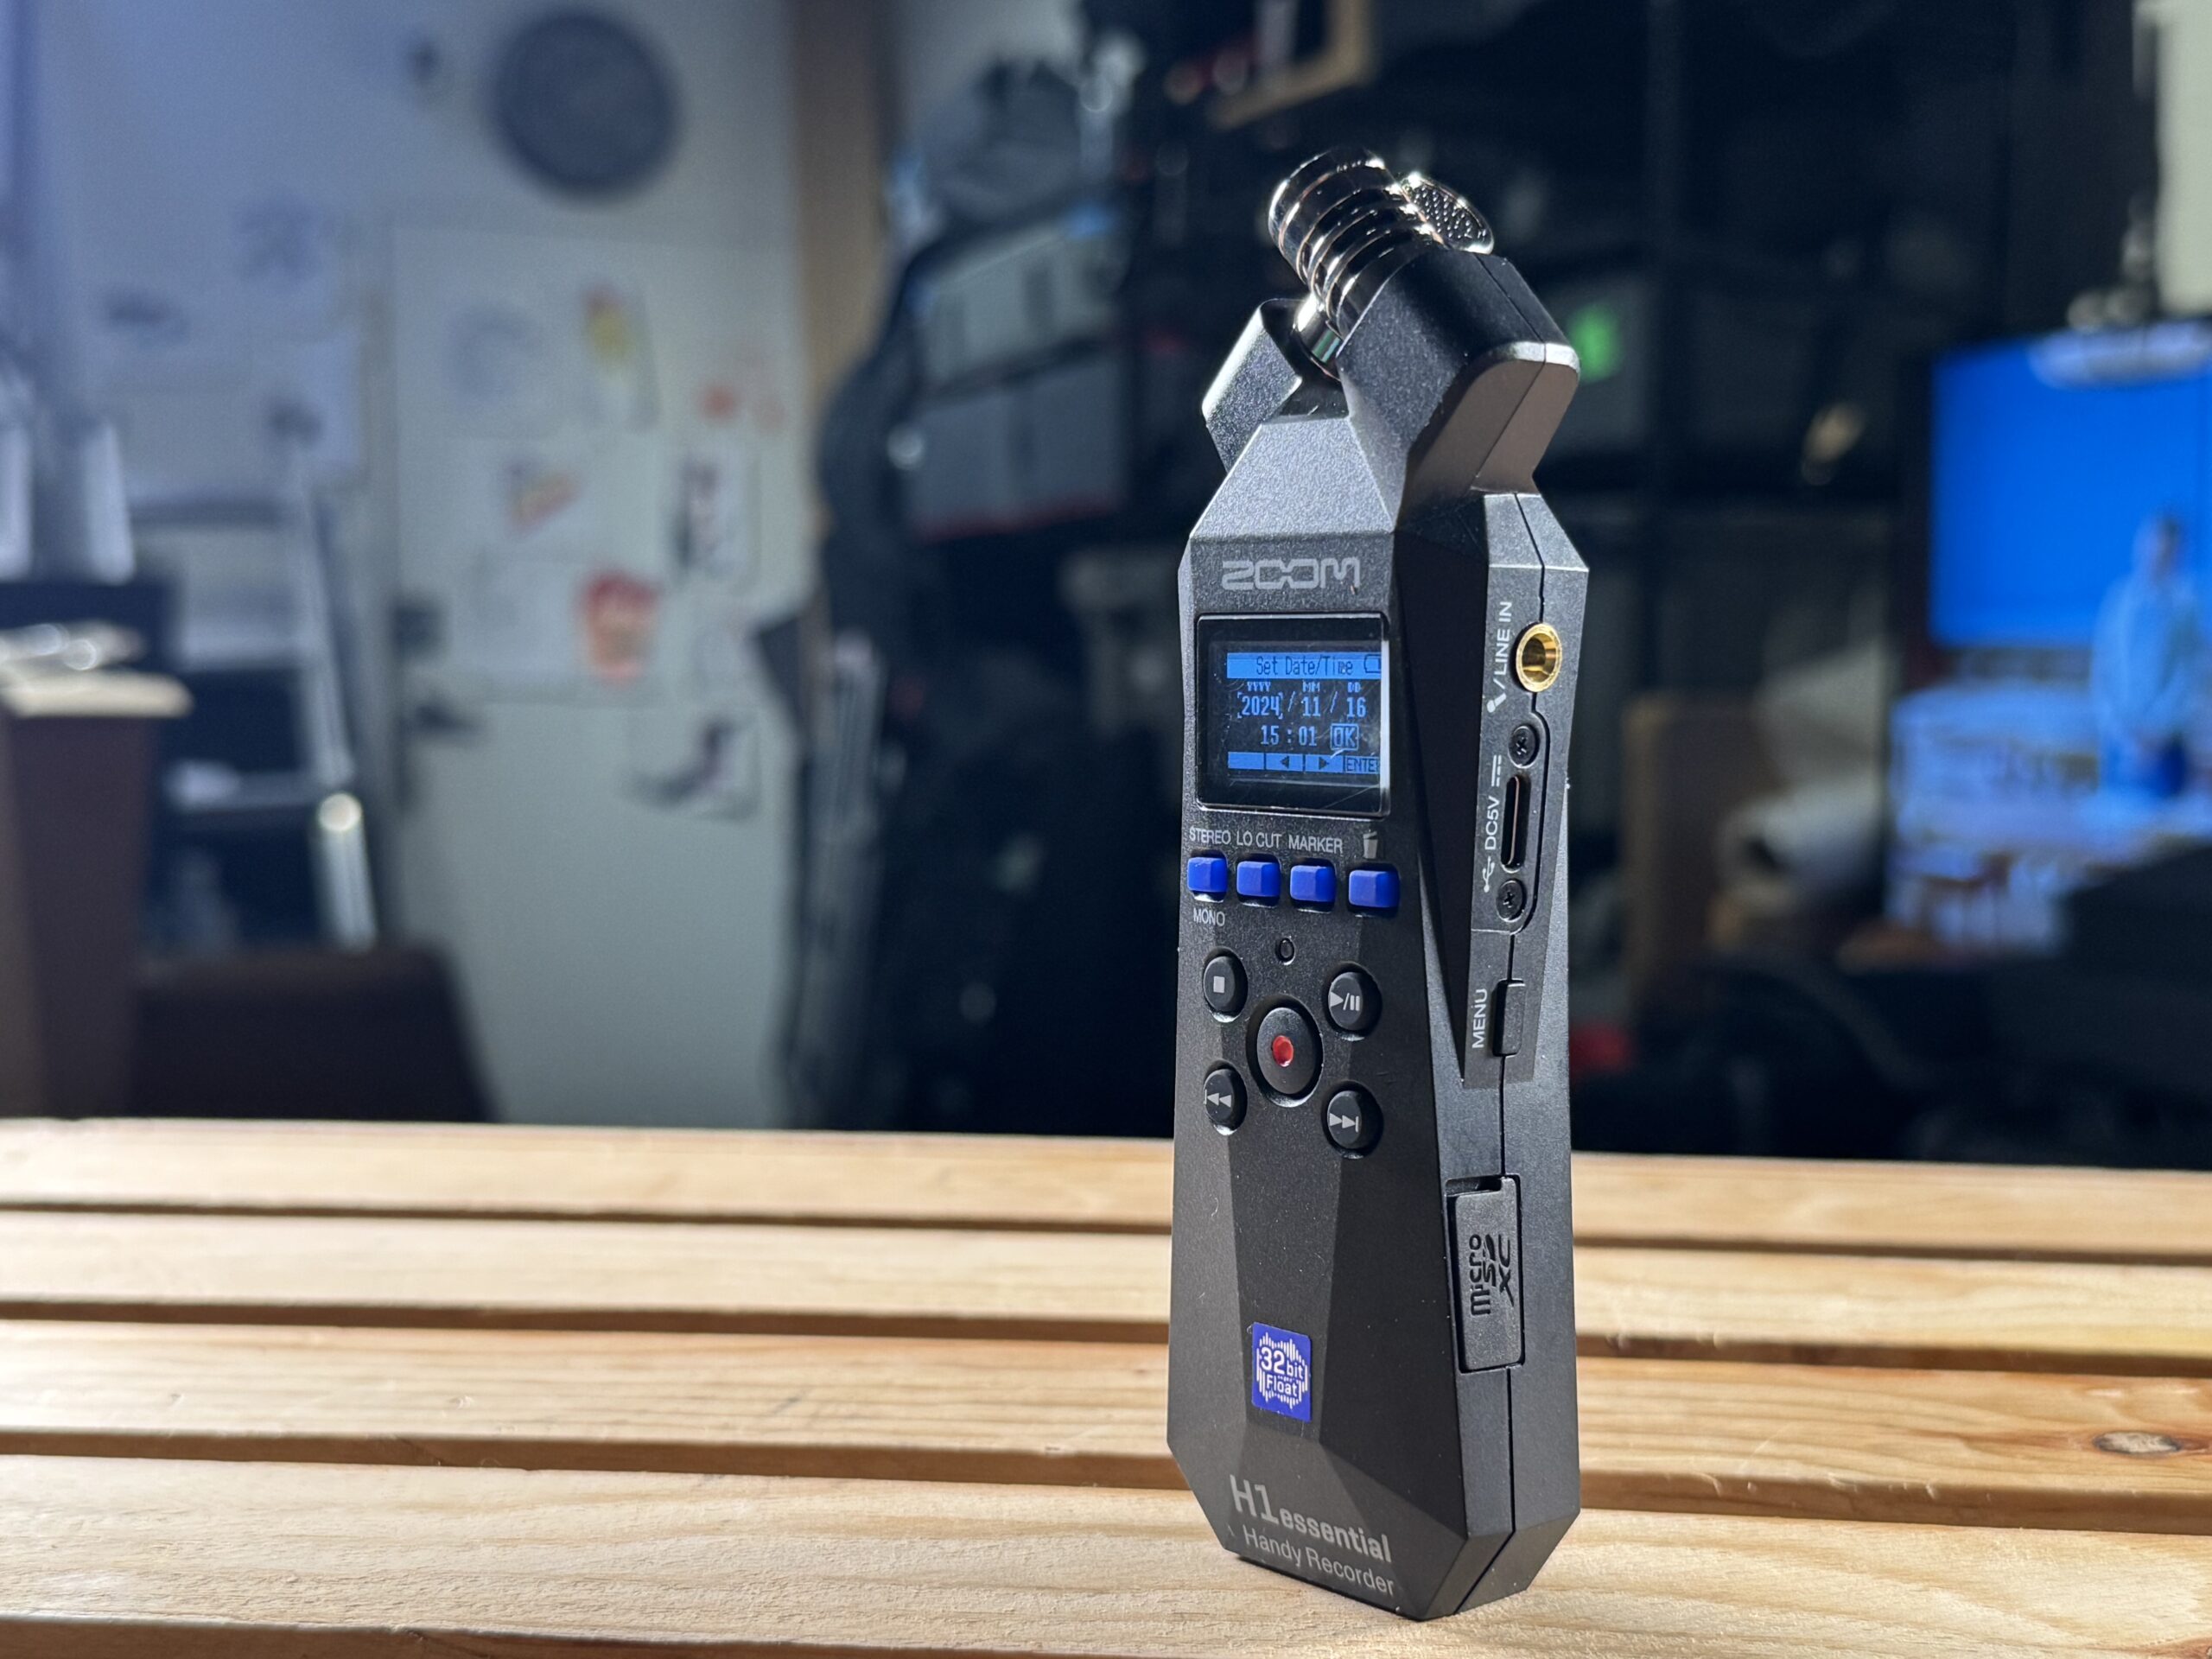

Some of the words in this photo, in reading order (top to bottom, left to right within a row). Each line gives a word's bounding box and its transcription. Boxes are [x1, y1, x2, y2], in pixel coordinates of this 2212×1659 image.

[1222, 557, 1360, 590] ZOOM
[1498, 601, 1512, 624] IN
[1256, 656, 1278, 676] Set
[1285, 655, 1353, 676] Date/Time
[1247, 681, 1271, 692] YYYY
[1302, 681, 1320, 693] MM
[1347, 682, 1361, 693] DD
[1333, 727, 1356, 747] OK
[1484, 796, 1500, 851] DC5V
[1189, 826, 1231, 846] STEREO
[1236, 830, 1253, 847] LO
[1255, 831, 1282, 849] CUT
[1288, 835, 1344, 854] MARKER
[1193, 908, 1226, 927] MONO
[1471, 988, 1489, 1049] MENU
[1469, 1234, 1491, 1316] micro
[1498, 1234, 1515, 1307] XC
[1266, 1374, 1298, 1397] Float
[1243, 1524, 1301, 1567] Handy
[1306, 1547, 1395, 1597] Recorder
